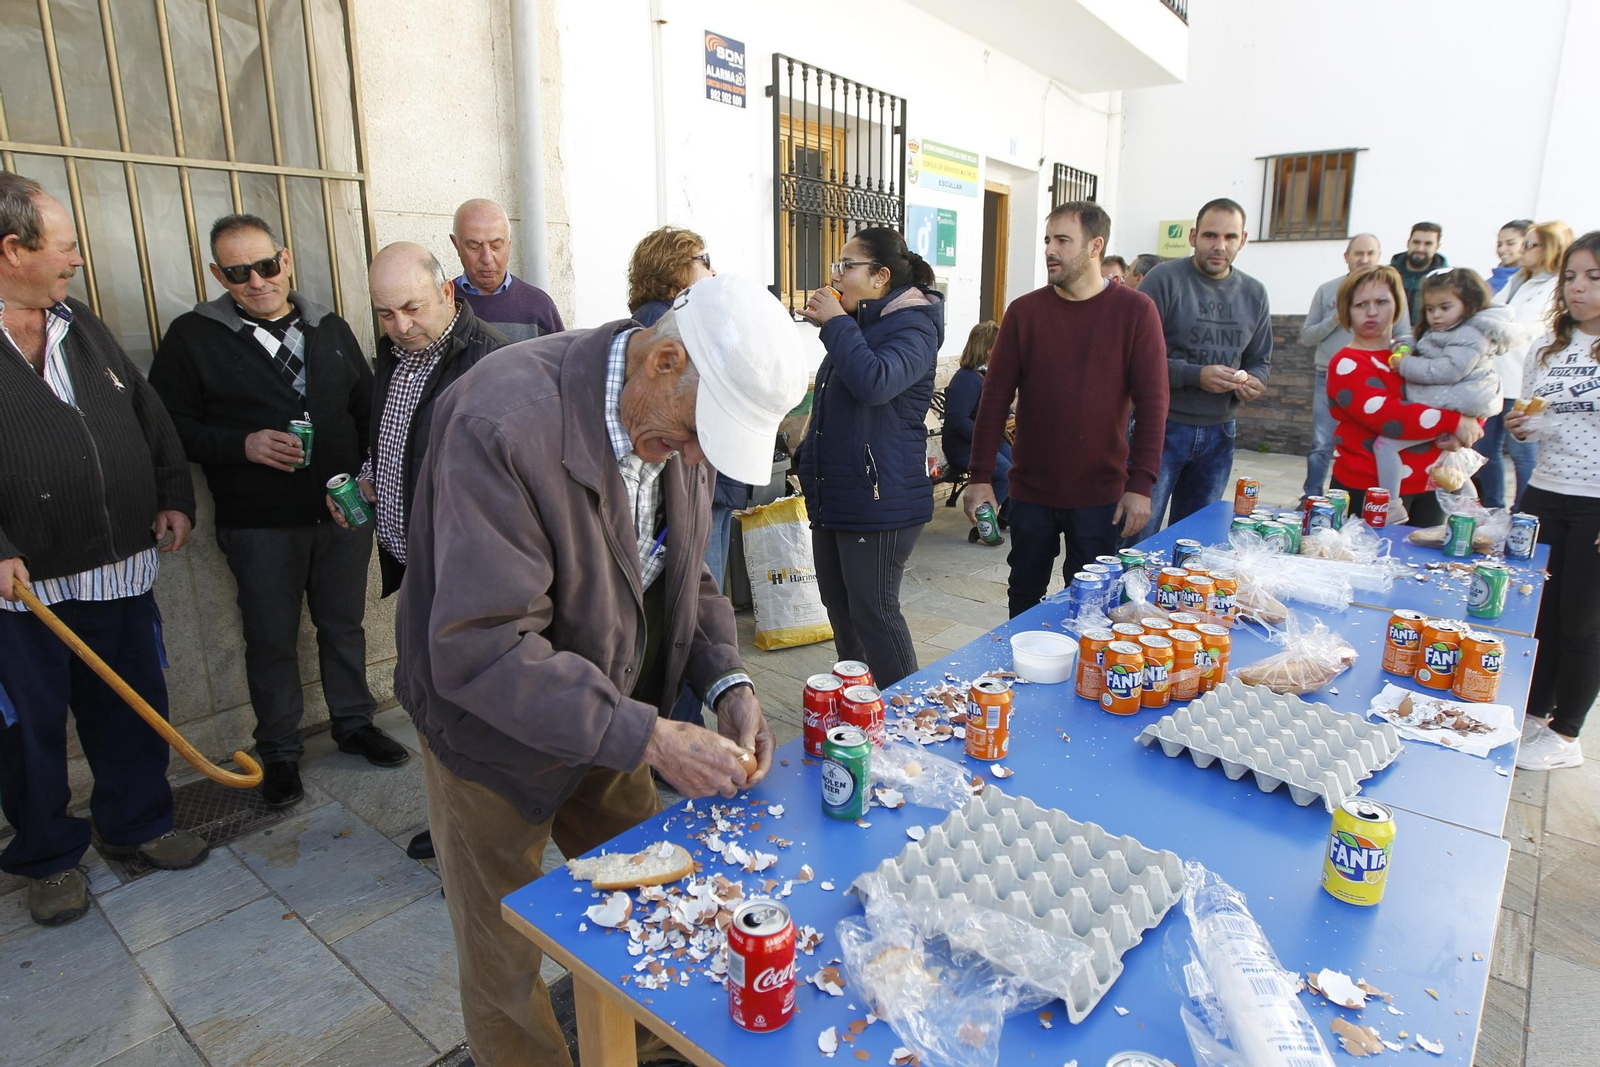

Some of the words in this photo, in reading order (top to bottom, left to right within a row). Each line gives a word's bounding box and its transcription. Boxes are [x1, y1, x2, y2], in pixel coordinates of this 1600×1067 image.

[716, 45, 744, 66] SDN
[706, 64, 735, 83] ALARMA
[1189, 325, 1243, 347] SAINT
[1550, 367, 1594, 376] TOTALLY
[1552, 402, 1592, 412] MYSELF
[1389, 626, 1418, 641] FANTA
[1329, 833, 1387, 870] FANTA
